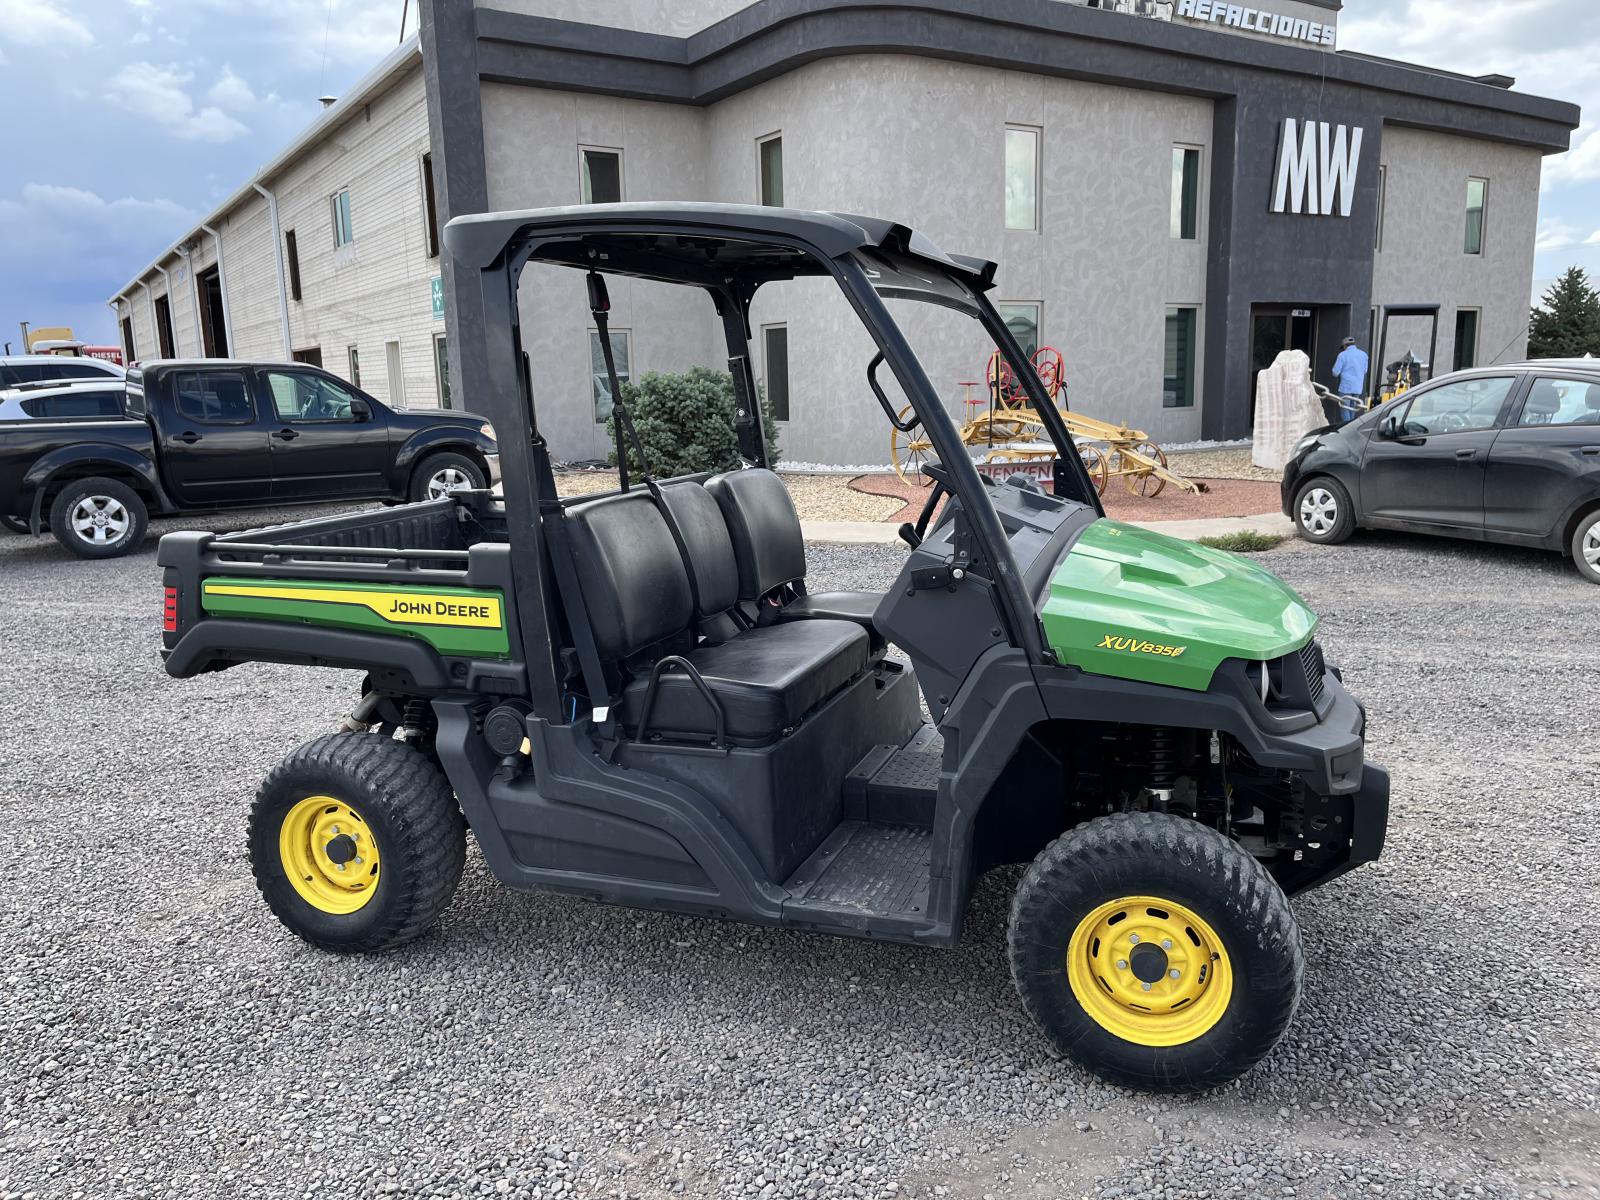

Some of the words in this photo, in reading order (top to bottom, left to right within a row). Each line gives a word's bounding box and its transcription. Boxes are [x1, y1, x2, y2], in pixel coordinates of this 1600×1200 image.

[1178, 0, 1336, 45] REFACCIONES
[1272, 118, 1364, 217] MW
[91, 351, 122, 359] DIESEL
[390, 600, 431, 615] JOHN
[436, 602, 489, 618] DEERE
